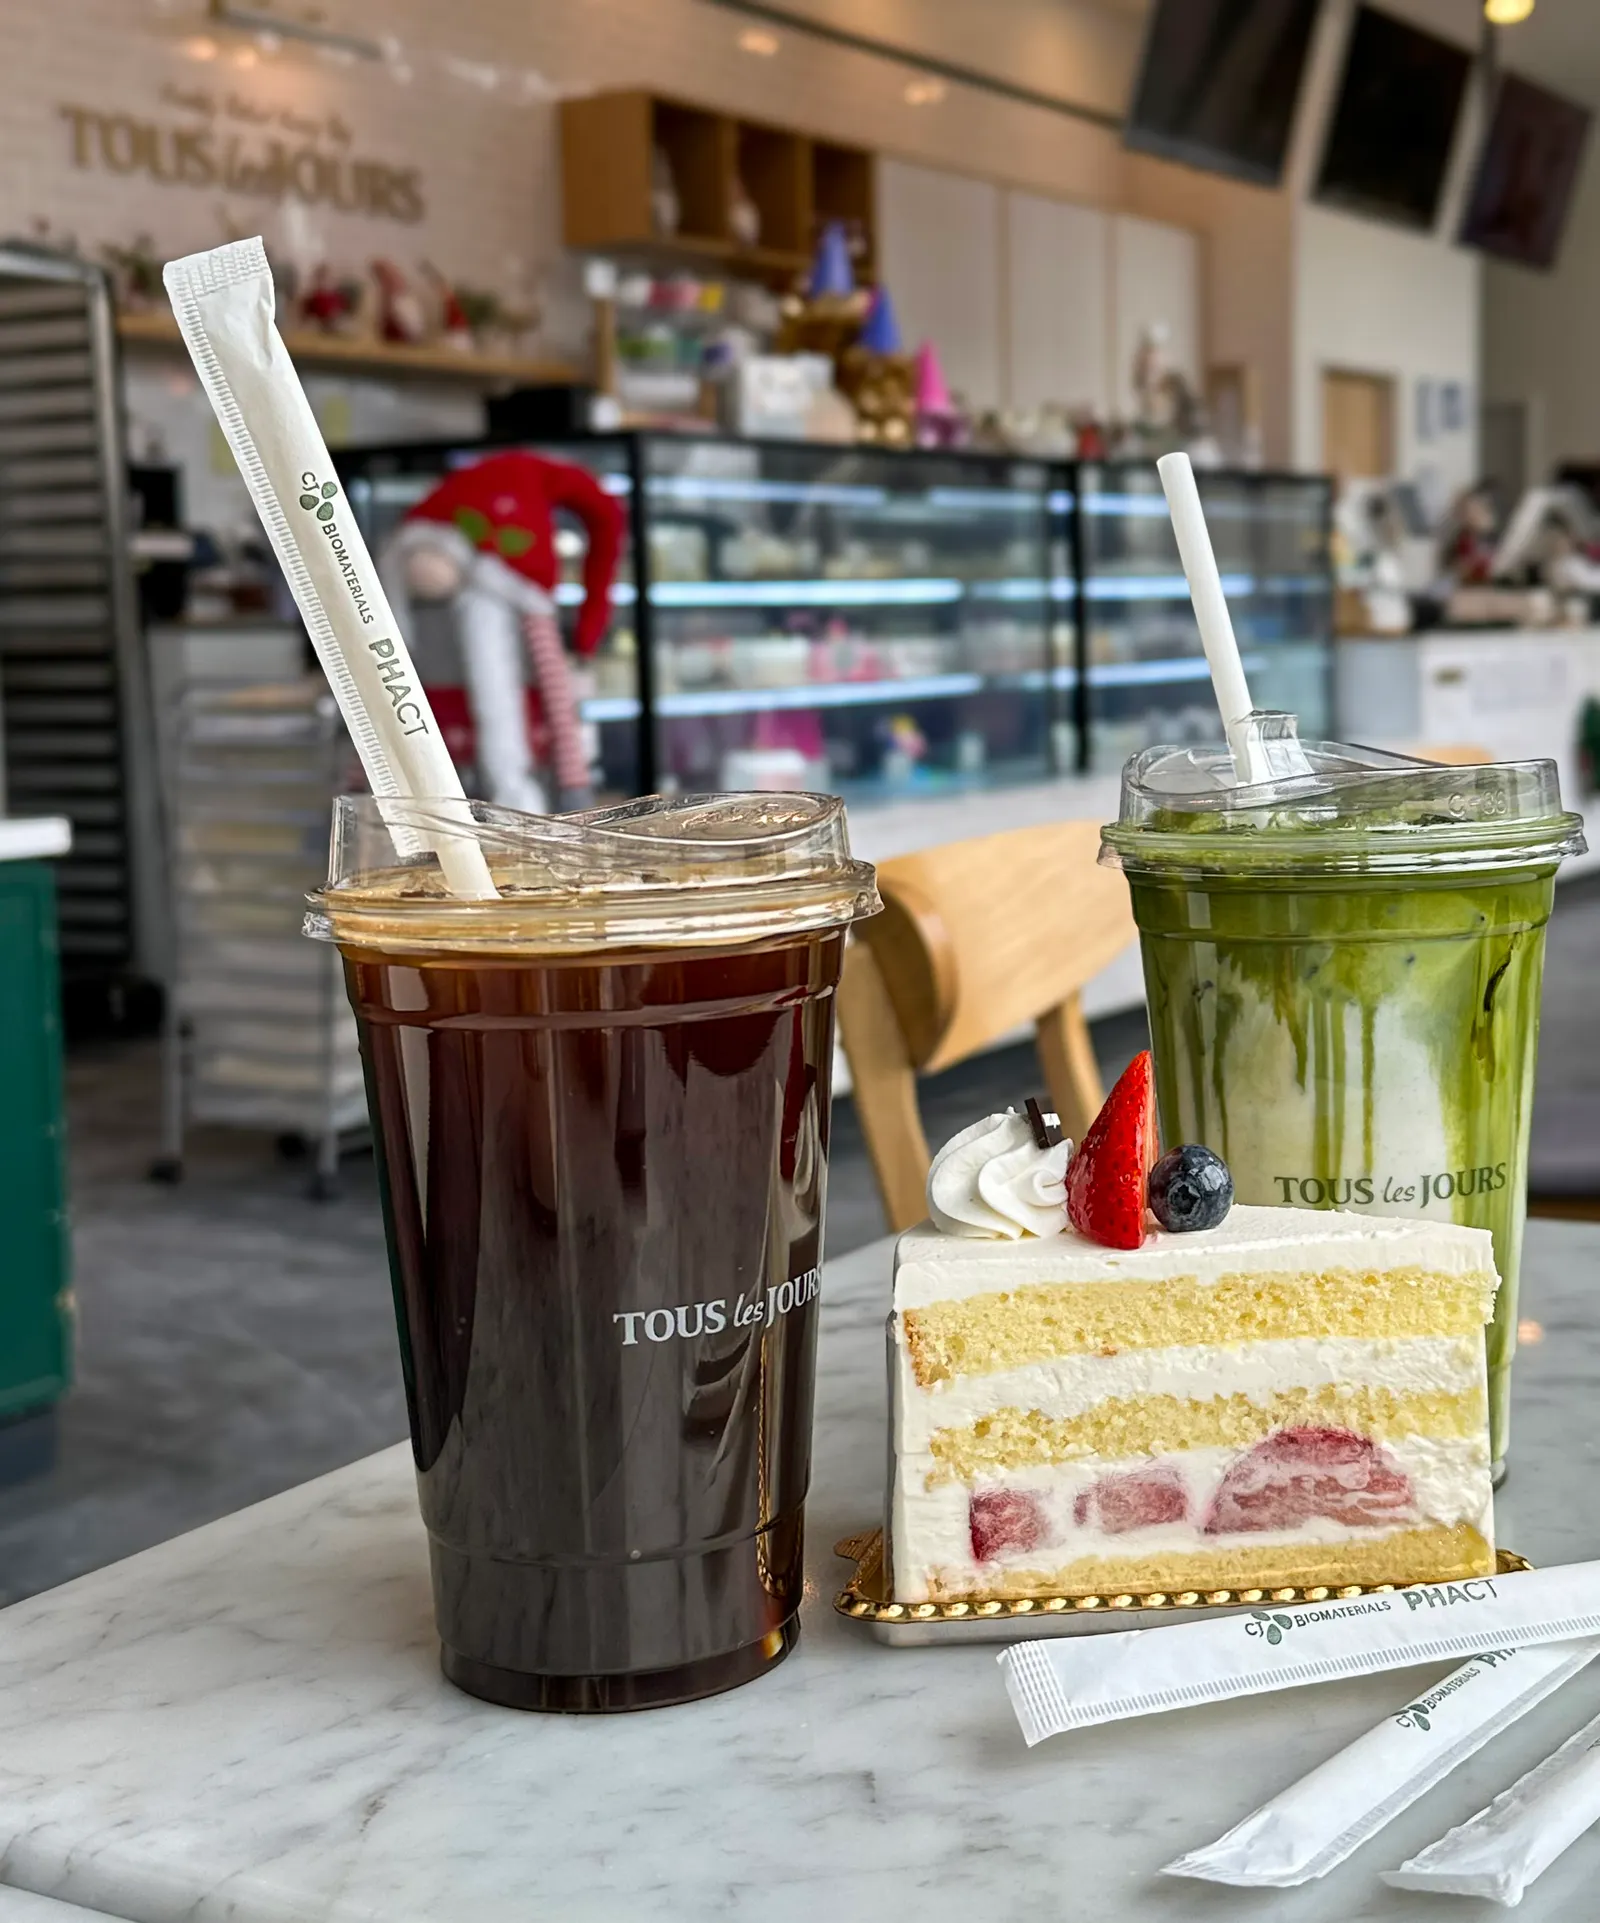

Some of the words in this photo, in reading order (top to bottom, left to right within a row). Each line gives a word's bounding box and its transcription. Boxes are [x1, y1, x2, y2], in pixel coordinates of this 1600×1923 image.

[58, 101, 218, 186] TOUS
[302, 471, 320, 491] CJ
[321, 522, 374, 625] BIOMATERIALS
[369, 638, 429, 736] PHACT
[1274, 1176, 1375, 1205] TOUS
[1383, 1176, 1415, 1203] les
[1420, 1162, 1507, 1209] JOURS
[612, 1299, 726, 1346] TOUS
[733, 1293, 764, 1327] les
[1245, 1621, 1264, 1637] CJ
[1294, 1600, 1391, 1628] BIOMATERIALS
[1401, 1578, 1498, 1611] PHACT
[1422, 1666, 1480, 1710] BIOMATERIALS
